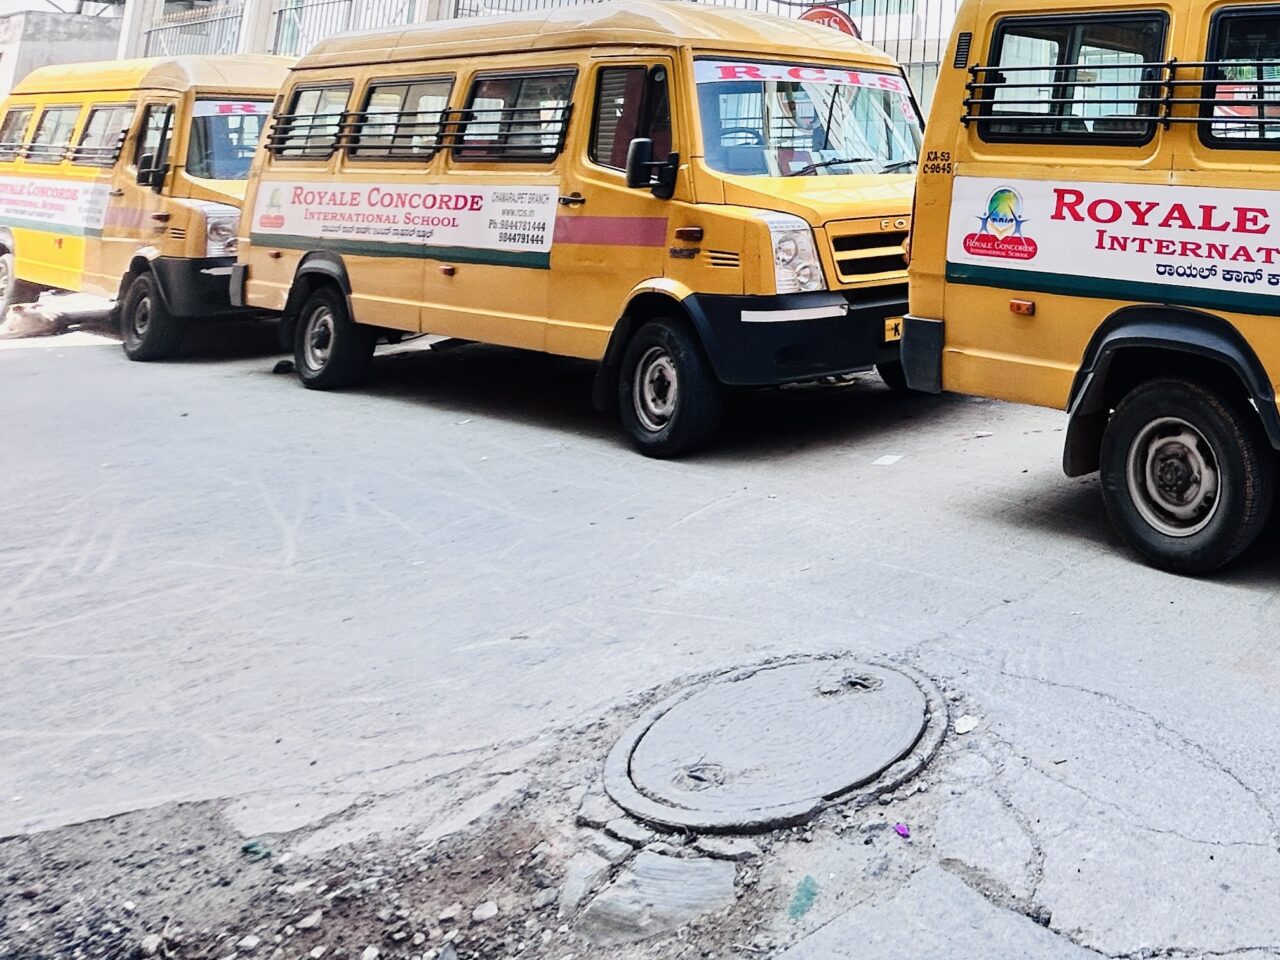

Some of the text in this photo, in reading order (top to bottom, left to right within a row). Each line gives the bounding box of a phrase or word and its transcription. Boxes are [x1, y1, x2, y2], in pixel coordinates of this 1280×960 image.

[926, 151, 951, 162] KA-53
[923, 163, 952, 174] C-9645
[291, 186, 483, 211] ROYALE CONCORDE
[304, 208, 459, 227] INTERNATIONAL SCHOOL
[1050, 188, 1271, 234] ROYALE
[1155, 263, 1217, 279] ರಾಯಲ್
